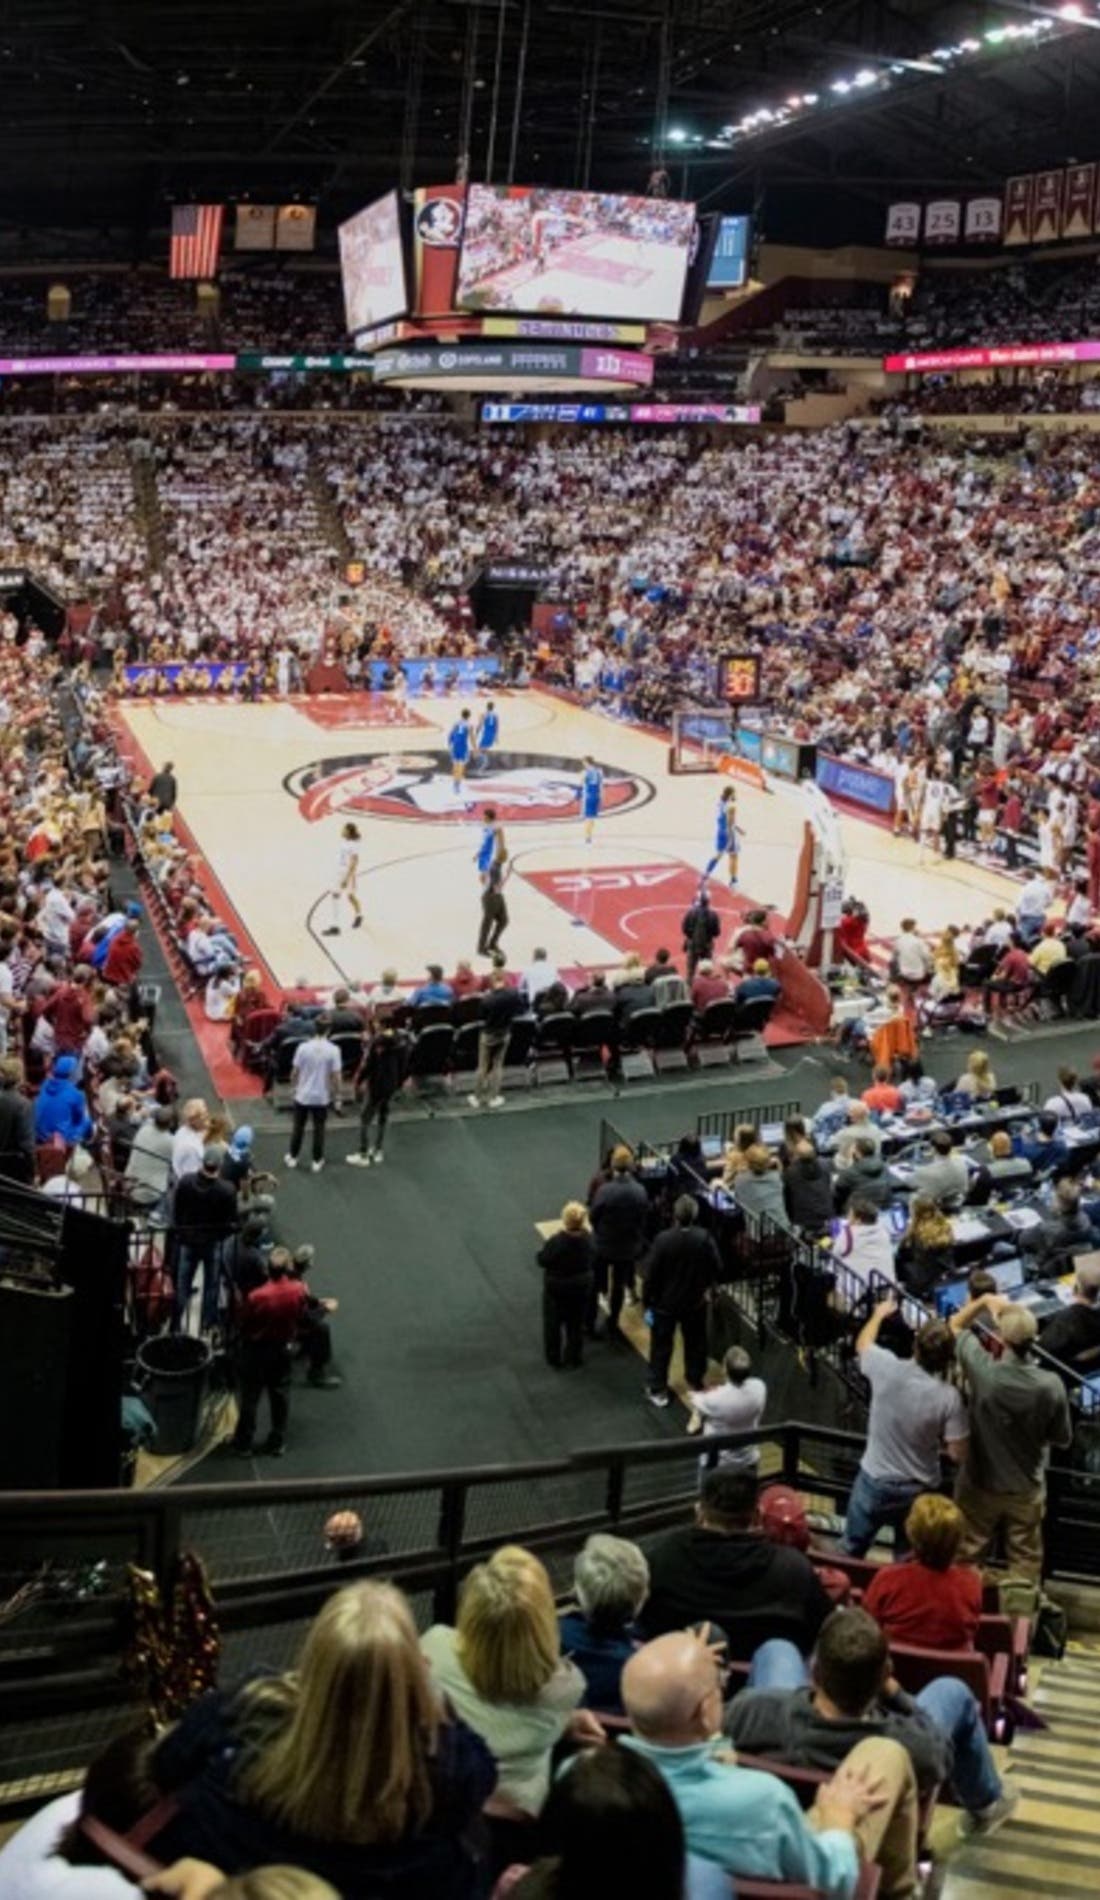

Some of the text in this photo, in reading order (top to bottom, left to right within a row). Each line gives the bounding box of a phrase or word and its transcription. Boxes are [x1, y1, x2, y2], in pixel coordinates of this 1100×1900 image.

[891, 215, 916, 231] 43
[930, 212, 955, 229] 25
[974, 210, 995, 227] 13
[553, 867, 686, 892] ACC
